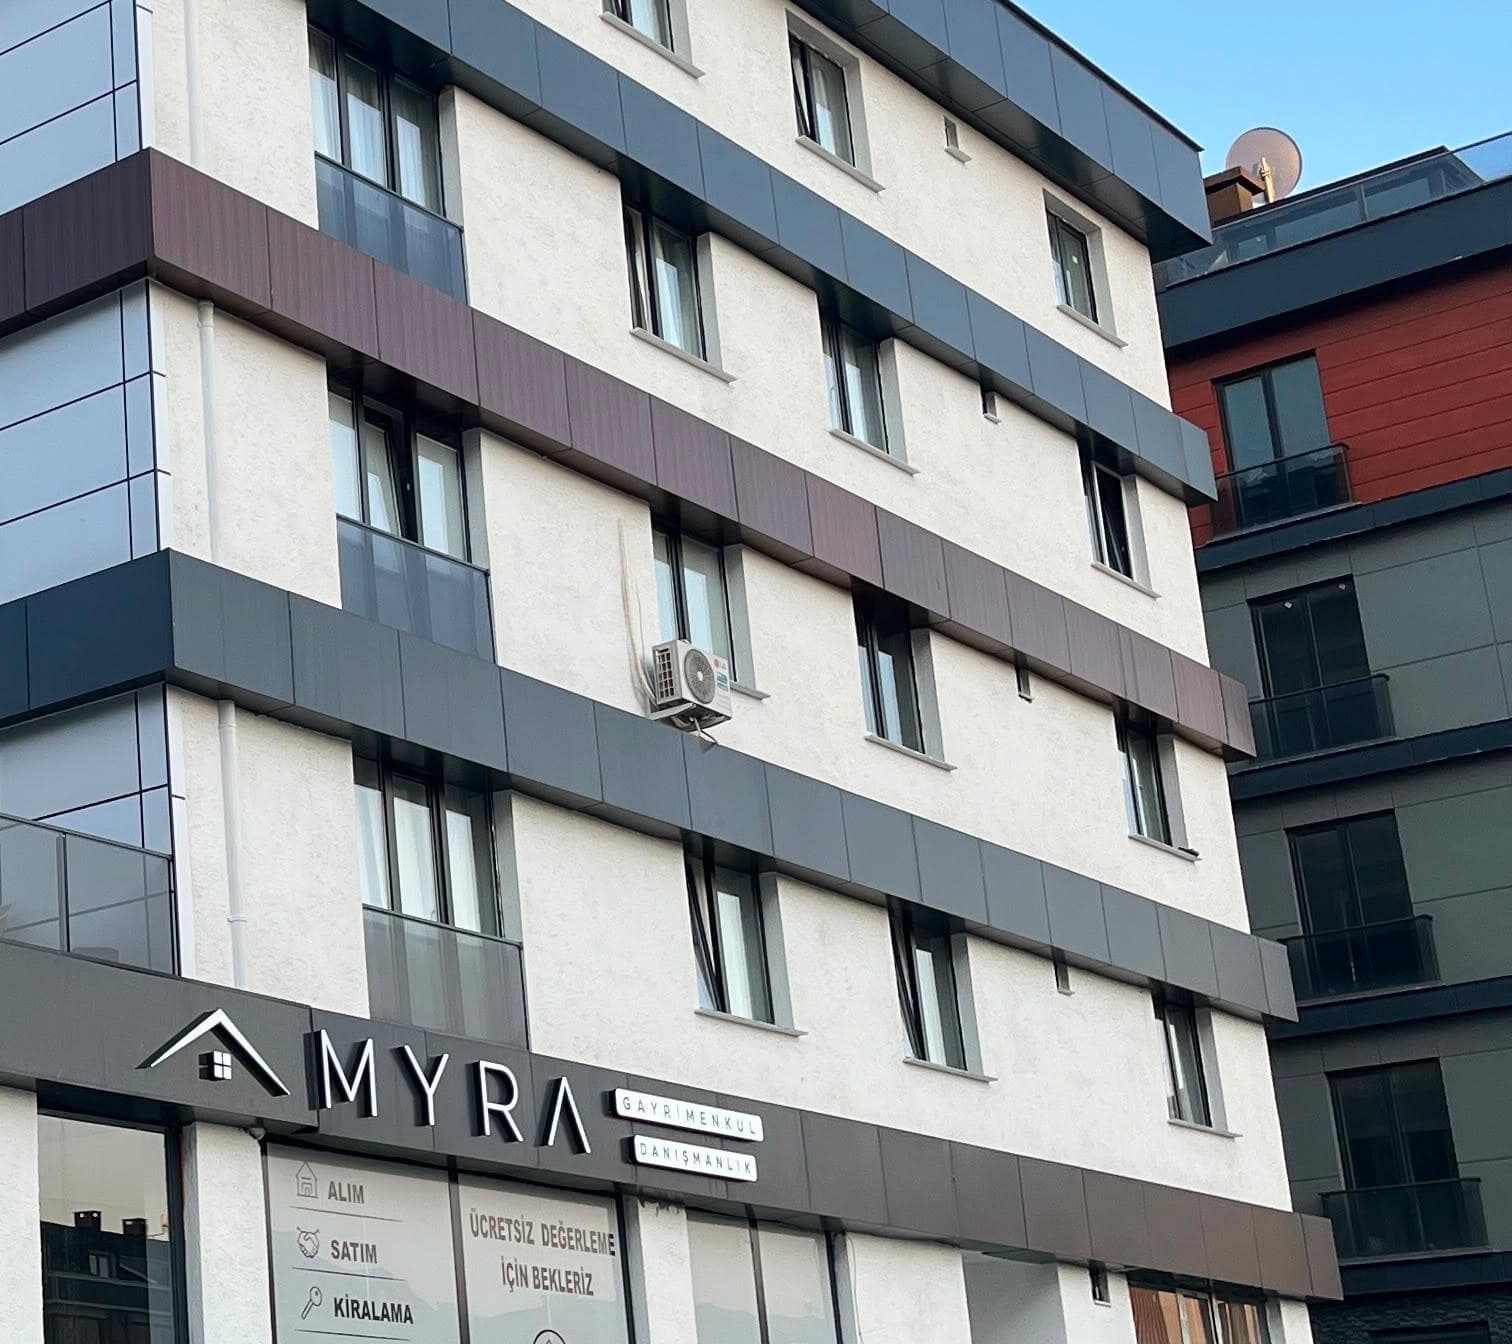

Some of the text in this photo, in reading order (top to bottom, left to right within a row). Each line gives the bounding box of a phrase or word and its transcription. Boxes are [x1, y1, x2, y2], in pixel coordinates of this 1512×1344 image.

[320, 1029, 591, 1154] MYRA
[640, 1142, 751, 1174] DANIŞMANLIK
[327, 1180, 365, 1204] ALIM
[469, 1207, 616, 1257] ÜCRETSİZ DEĞERLEME
[330, 1239, 378, 1265] SATIM
[500, 1255, 595, 1297] İÇİN BEKLERİZ
[333, 1293, 415, 1325] KİRALAMA
